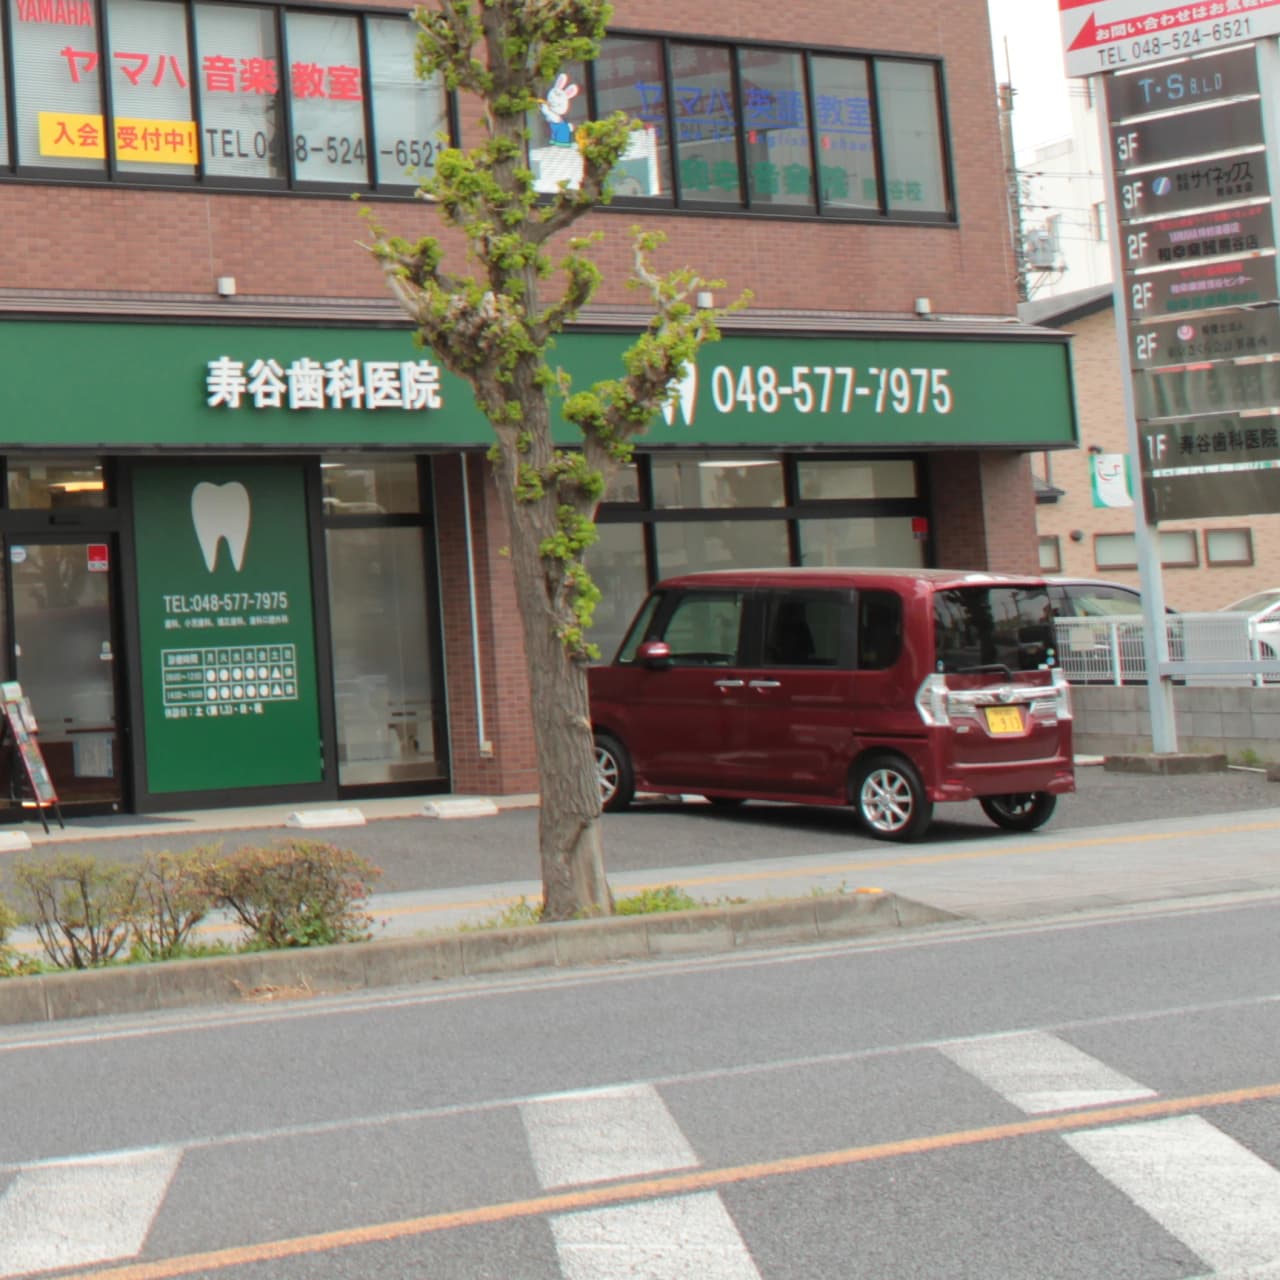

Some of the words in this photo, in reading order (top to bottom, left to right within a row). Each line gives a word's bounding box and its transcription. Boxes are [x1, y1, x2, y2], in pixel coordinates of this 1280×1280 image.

[1098, 48, 1127, 67] TEL
[1132, 17, 1253, 60] 048-524-6521
[60, 47, 363, 102] ヤマハ音楽教室
[634, 80, 871, 128] ヤマハ英語教室
[1117, 133, 1139, 161] 3F
[1122, 182, 1144, 209] 3F
[1127, 232, 1149, 260] 2F
[1132, 282, 1153, 310] 2F
[1136, 332, 1158, 360] 2F
[206, 356, 441, 410] 寿谷歯科医院
[711, 364, 953, 414] 048-577-7975
[1146, 433, 1168, 461] 1F
